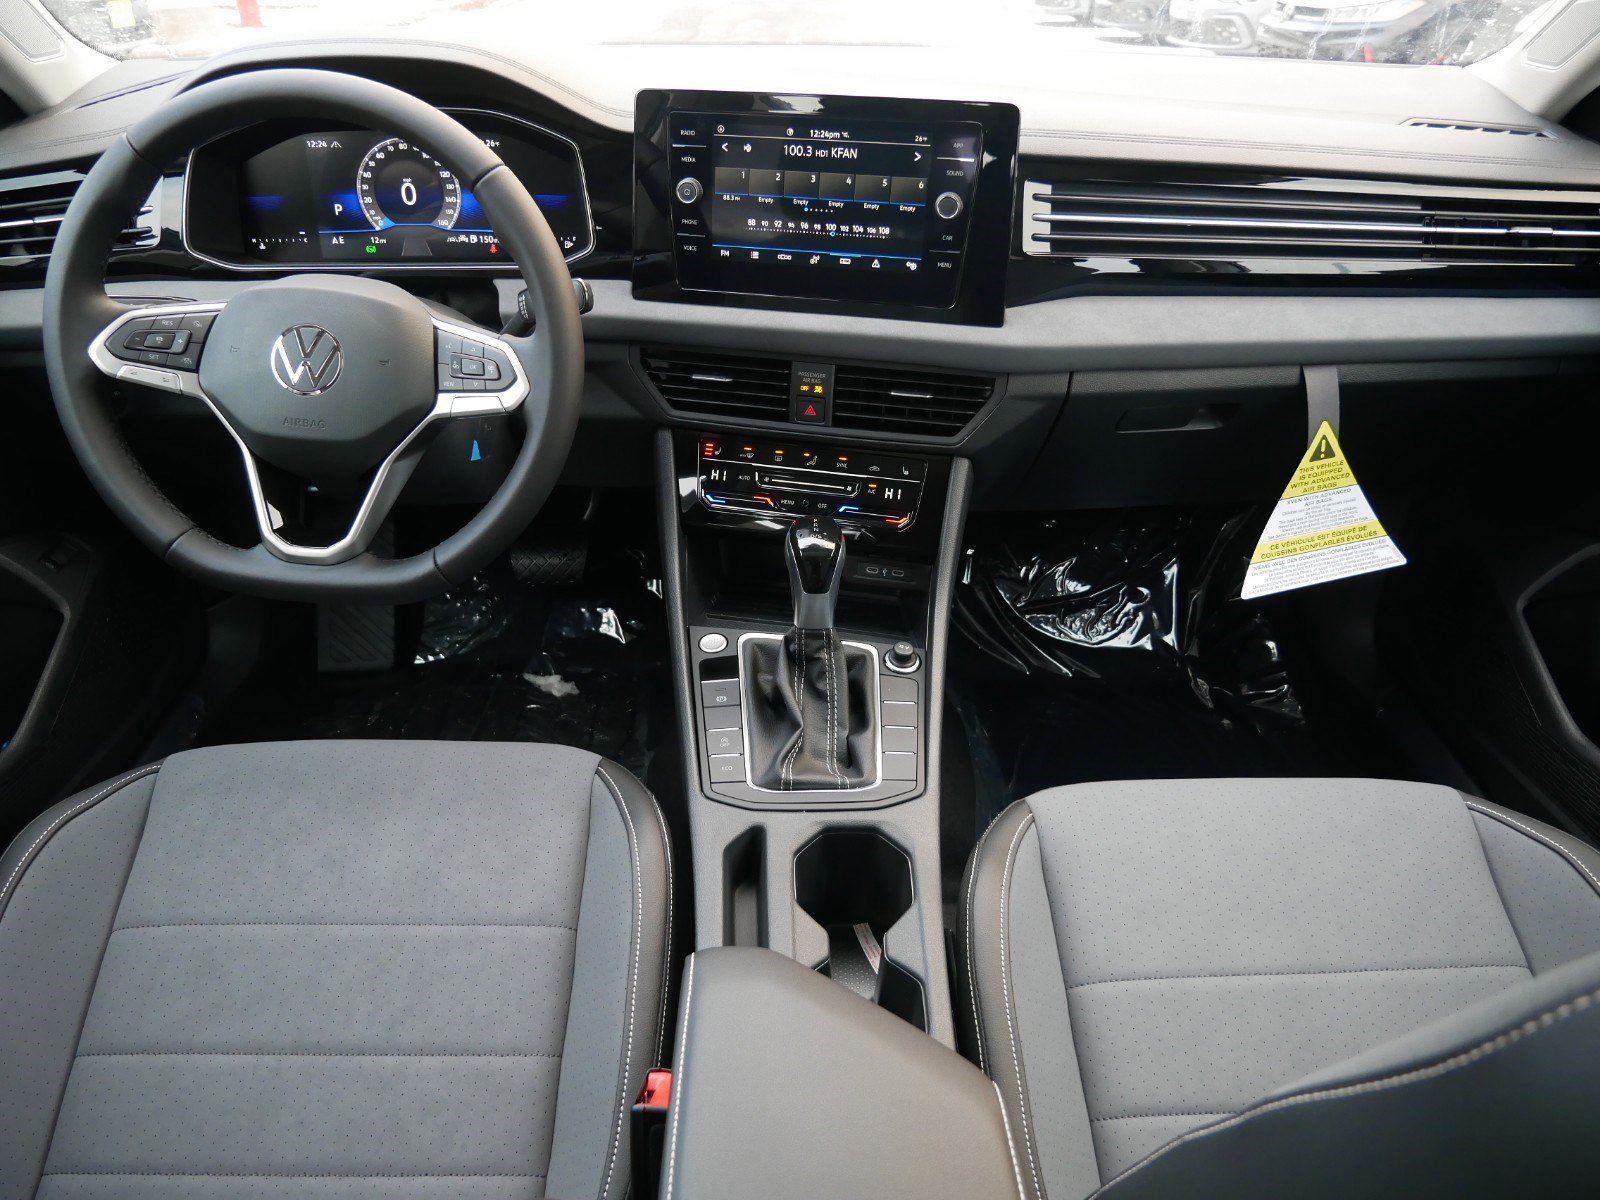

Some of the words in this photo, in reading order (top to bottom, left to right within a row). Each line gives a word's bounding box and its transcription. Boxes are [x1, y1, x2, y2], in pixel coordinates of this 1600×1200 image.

[810, 130, 840, 138] 12:24pm
[783, 145, 812, 157] 100.3
[832, 148, 858, 159] KFAN
[401, 183, 416, 206] 0
[334, 204, 343, 215] P
[282, 417, 326, 429] AIRBAG
[1300, 466, 1314, 474] THIS
[1316, 461, 1344, 470] VEHICLE
[1308, 467, 1342, 479] EQUIPPED
[1290, 481, 1309, 489] WITH
[1311, 473, 1350, 485] ADVANCED
[1317, 482, 1337, 490] BAGS
[1320, 488, 1352, 498] ADVANCED
[1281, 536, 1315, 548] VÉHICULE
[1332, 528, 1356, 537] ÉQUIPÉ
[1261, 547, 1297, 559] COUSSINS
[1299, 538, 1344, 552] GONFLABLES
[1346, 530, 1378, 541] ÉVOLUÉS
